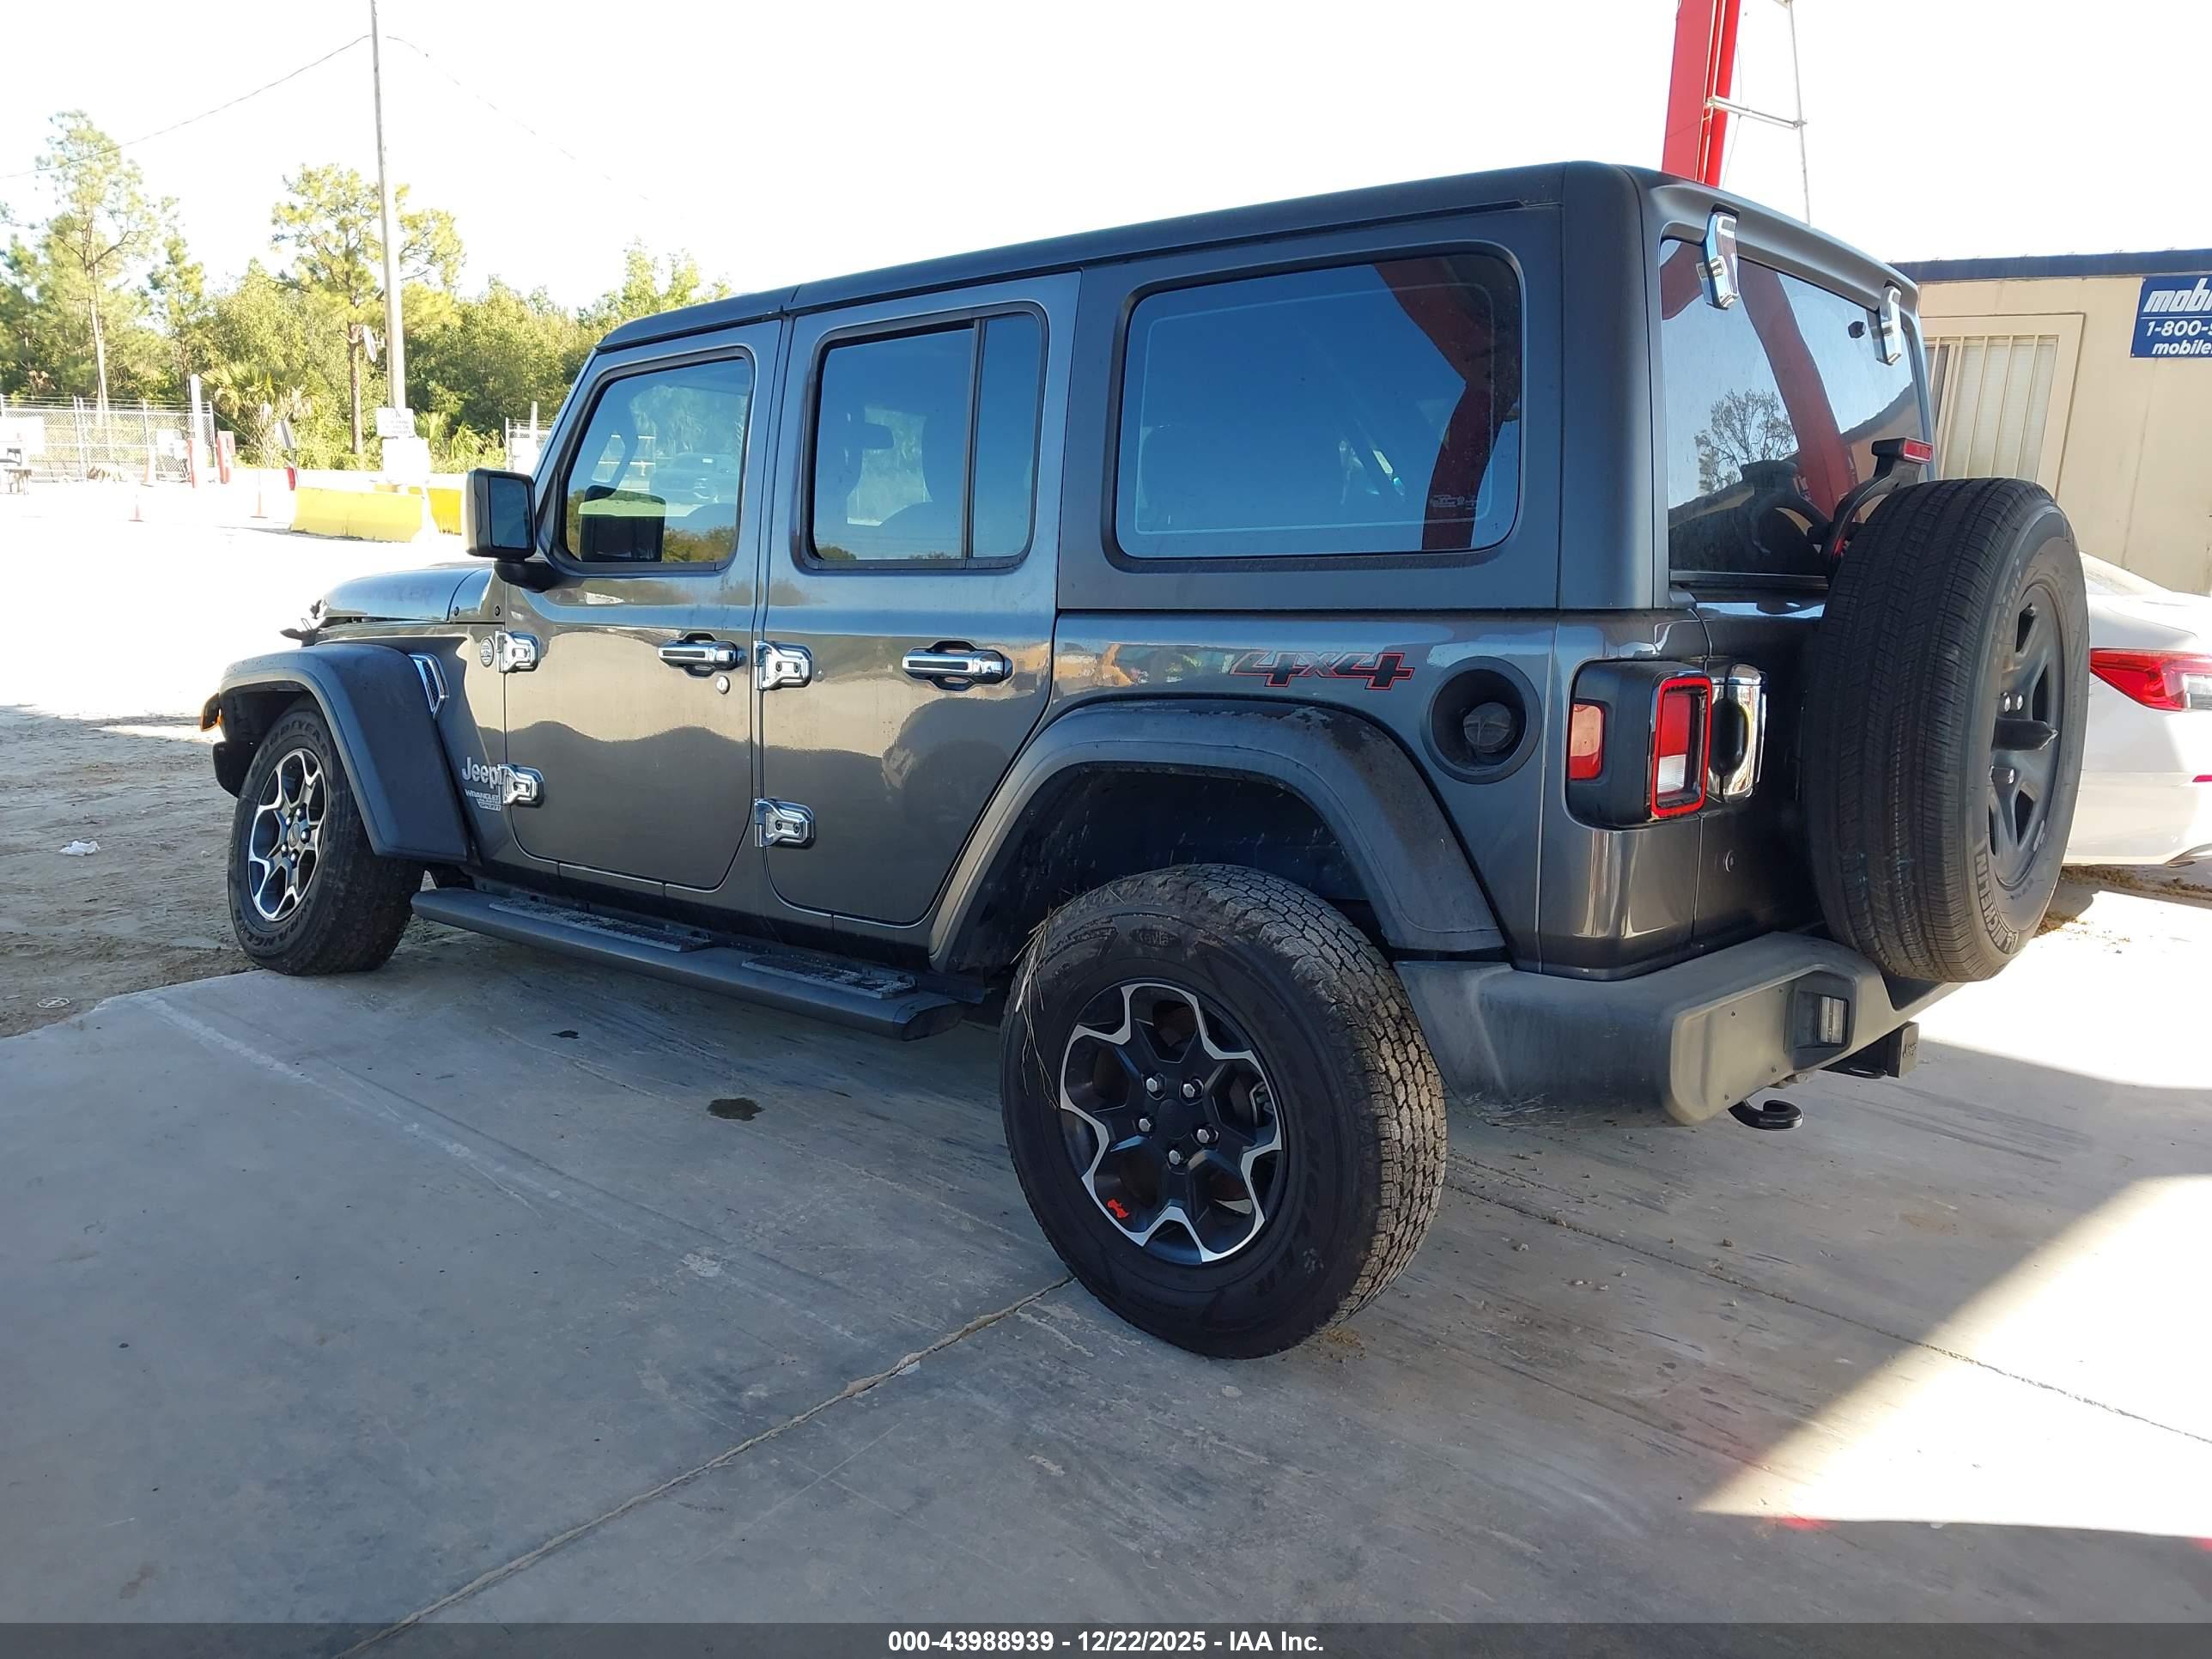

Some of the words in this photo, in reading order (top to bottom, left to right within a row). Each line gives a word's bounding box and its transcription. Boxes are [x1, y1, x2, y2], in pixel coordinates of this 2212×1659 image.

[2152, 339, 2212, 355] mobile
[462, 757, 499, 789] Jeep
[1975, 851, 2008, 948] MICHELIN
